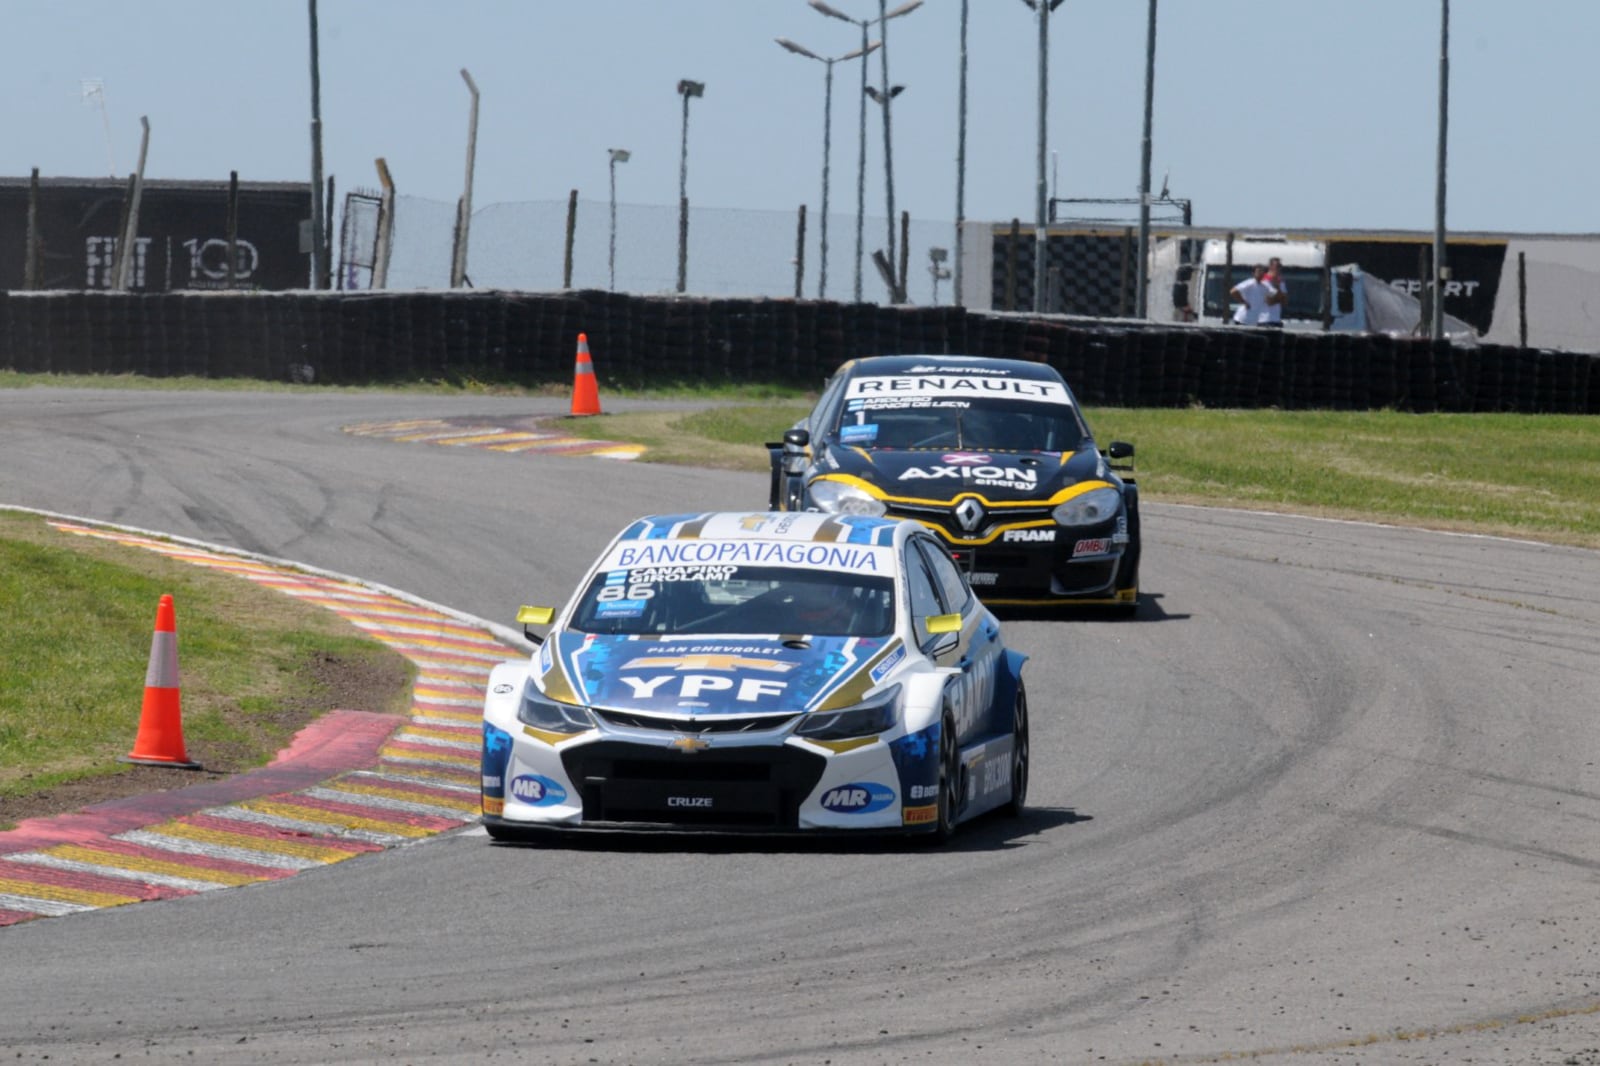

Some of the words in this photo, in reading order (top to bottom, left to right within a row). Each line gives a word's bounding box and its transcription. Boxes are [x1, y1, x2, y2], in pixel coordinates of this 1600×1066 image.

[1389, 278, 1480, 297] SPRT
[858, 378, 1057, 396] RENAULT
[911, 401, 930, 409] DE
[854, 410, 865, 426] 1
[898, 466, 1038, 481] AXION
[975, 477, 1038, 491] energy
[1003, 529, 1056, 542] FRAM
[618, 542, 877, 571] BANCOPATAGONIA
[628, 572, 731, 584] GIROLAMI
[630, 565, 738, 576] CANAPINO
[596, 582, 656, 603] 86
[647, 646, 688, 654] PLAN
[690, 645, 783, 656] CHEVROLET
[619, 674, 788, 702] YPF
[512, 778, 542, 799] MR
[667, 796, 713, 807] CRUZE
[823, 789, 868, 807] MR
